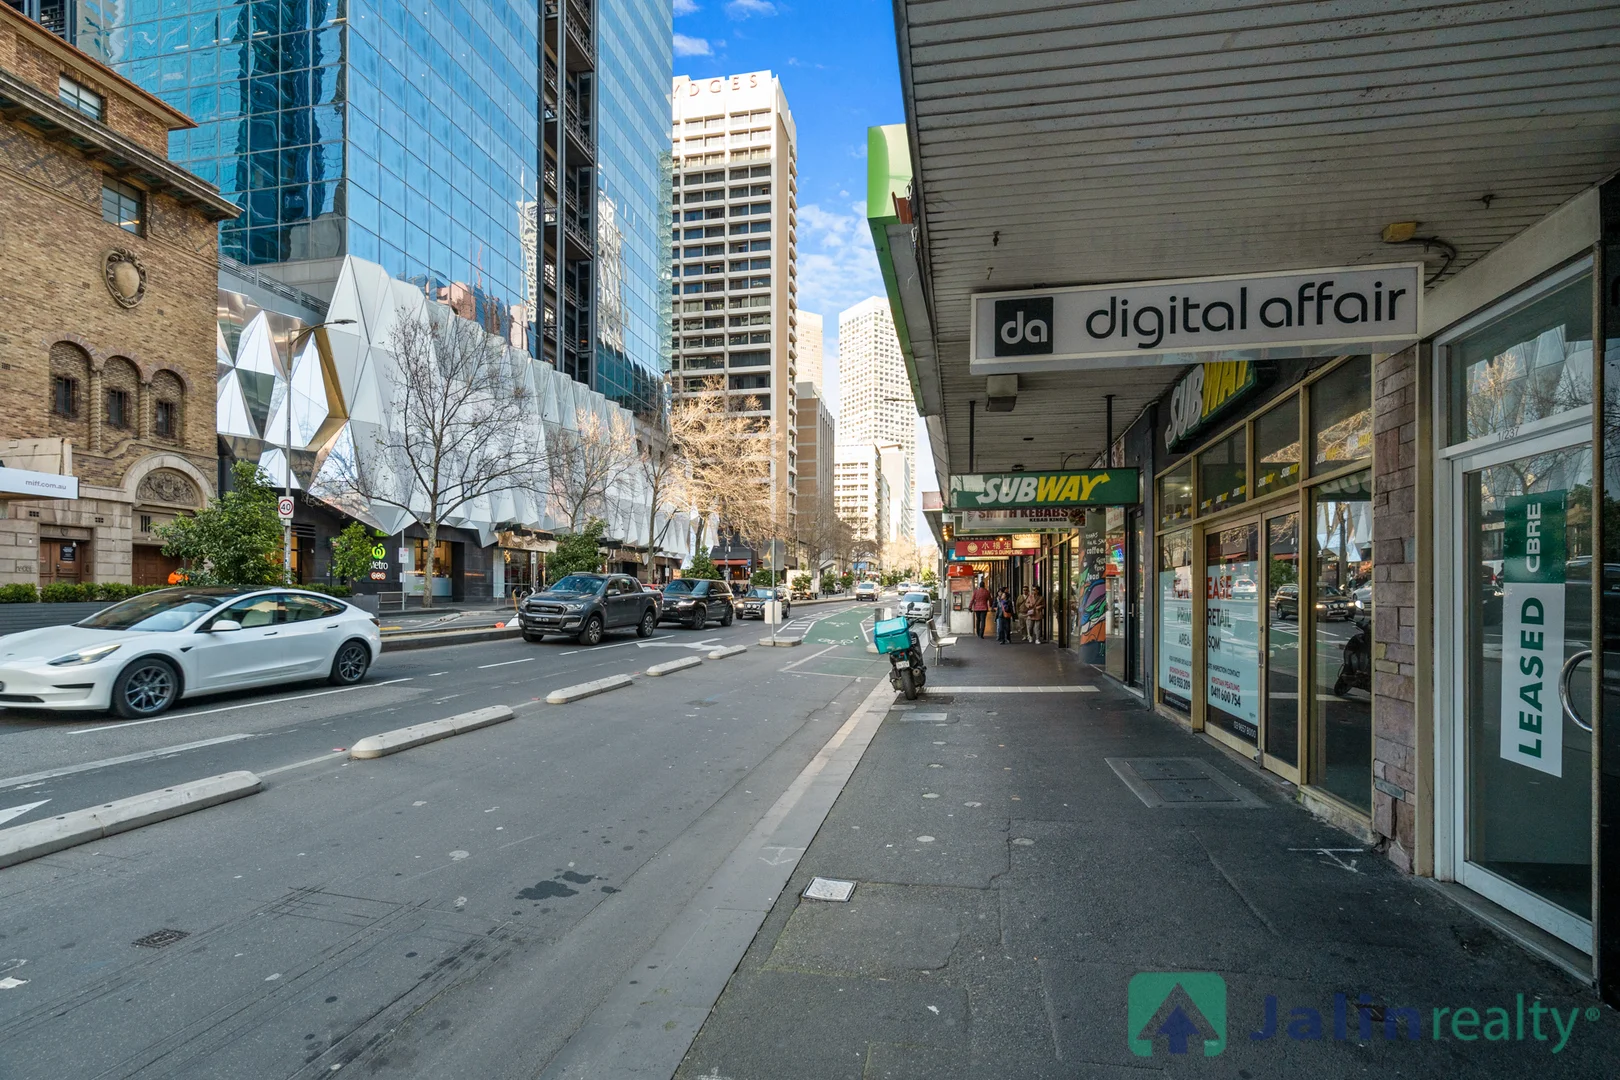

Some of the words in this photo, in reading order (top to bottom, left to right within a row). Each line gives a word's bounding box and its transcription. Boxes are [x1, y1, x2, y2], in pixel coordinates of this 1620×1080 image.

[1085, 286, 1247, 349] digital
[1260, 280, 1406, 327] affair
[1001, 311, 1048, 344] da
[1497, 426, 1520, 441] 1/237
[25, 479, 67, 490] miff.com.au
[975, 473, 1111, 505] SUBWAY
[280, 503, 291, 511] 40
[978, 508, 1017, 519] SMITH
[1021, 507, 1069, 518] KEBABS
[1526, 502, 1542, 573] CBRE
[1086, 546, 1104, 555] coffee
[1207, 575, 1232, 599] EASE
[1176, 606, 1192, 625] PRIM
[1207, 608, 1232, 628] RETAIL
[1518, 597, 1545, 759] LEASED
[1210, 685, 1221, 699] 0411
[1221, 689, 1231, 704] 600
[1231, 692, 1241, 708] 754
